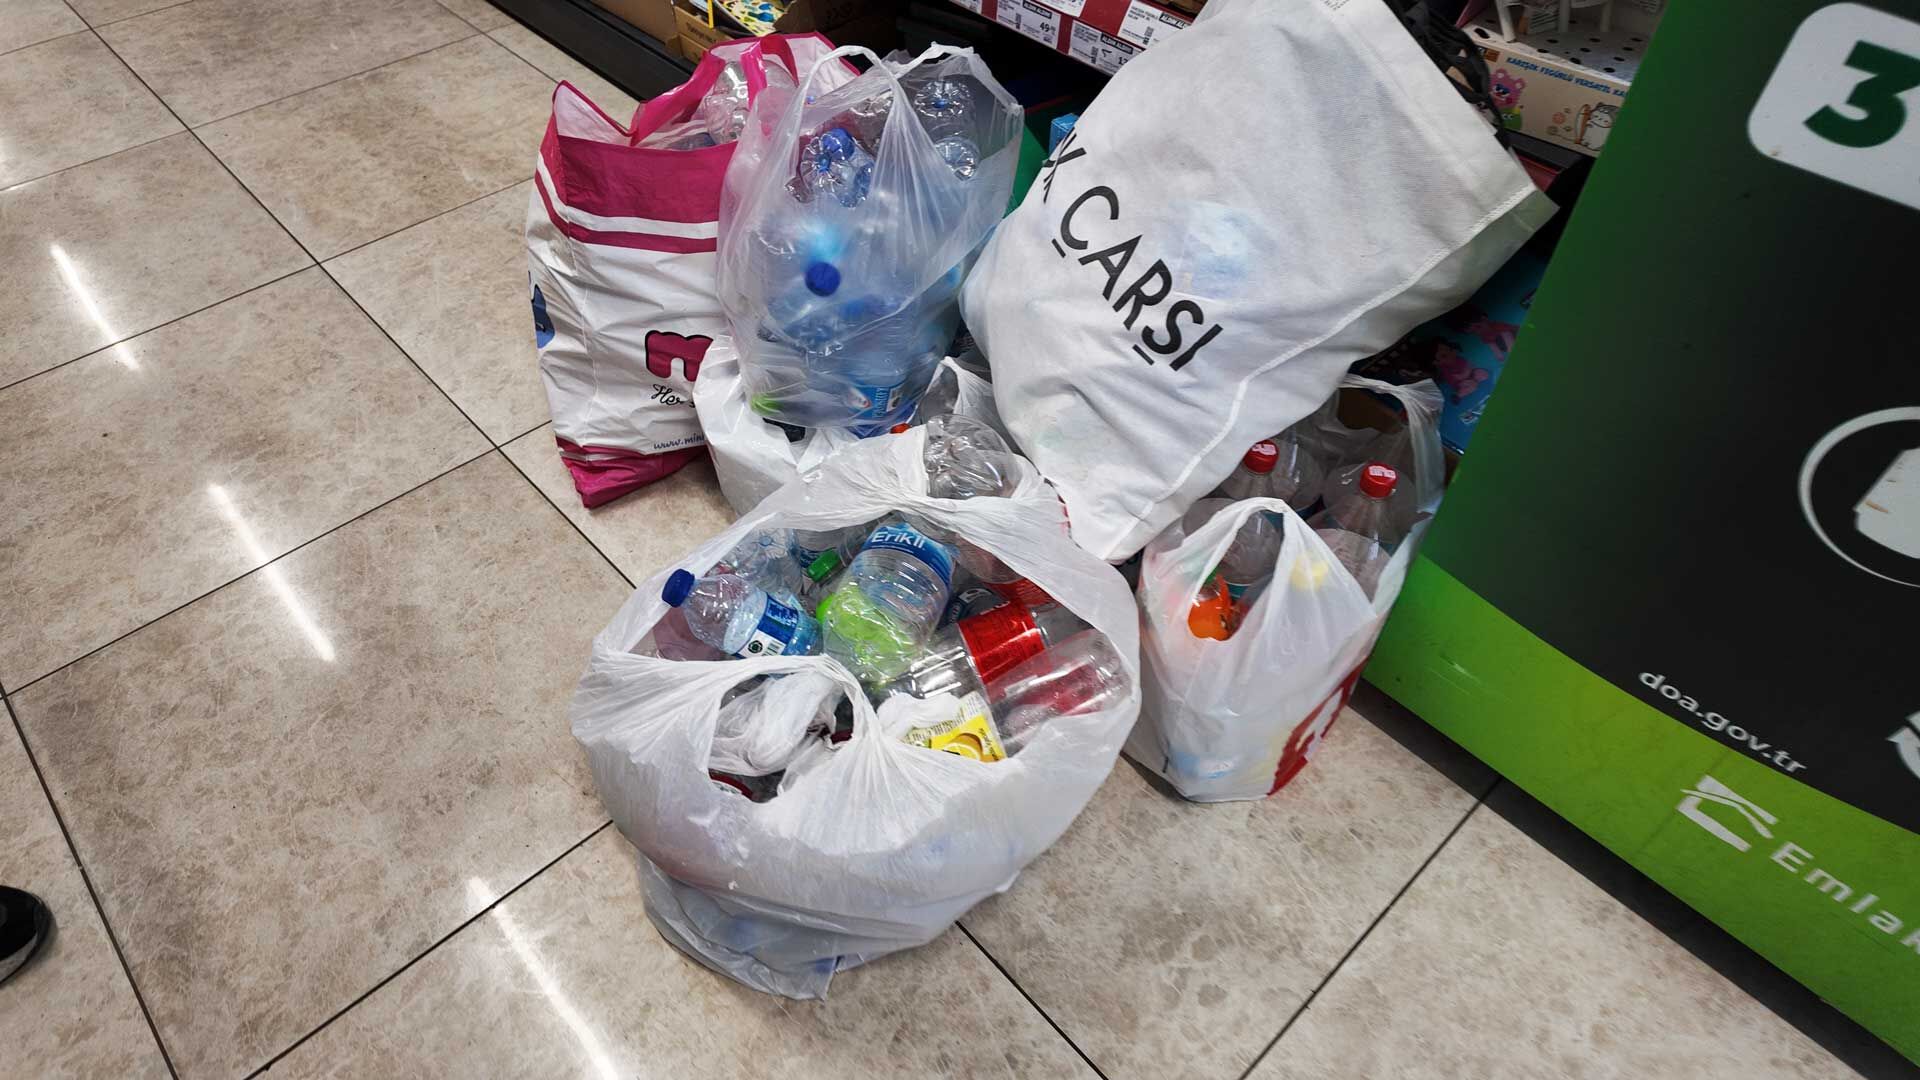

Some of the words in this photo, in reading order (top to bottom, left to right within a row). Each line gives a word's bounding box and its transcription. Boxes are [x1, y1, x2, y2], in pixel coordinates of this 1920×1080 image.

[1803, 39, 1920, 148] 3
[651, 384, 684, 406] Her
[1638, 671, 1807, 773] doa.gov.tr
